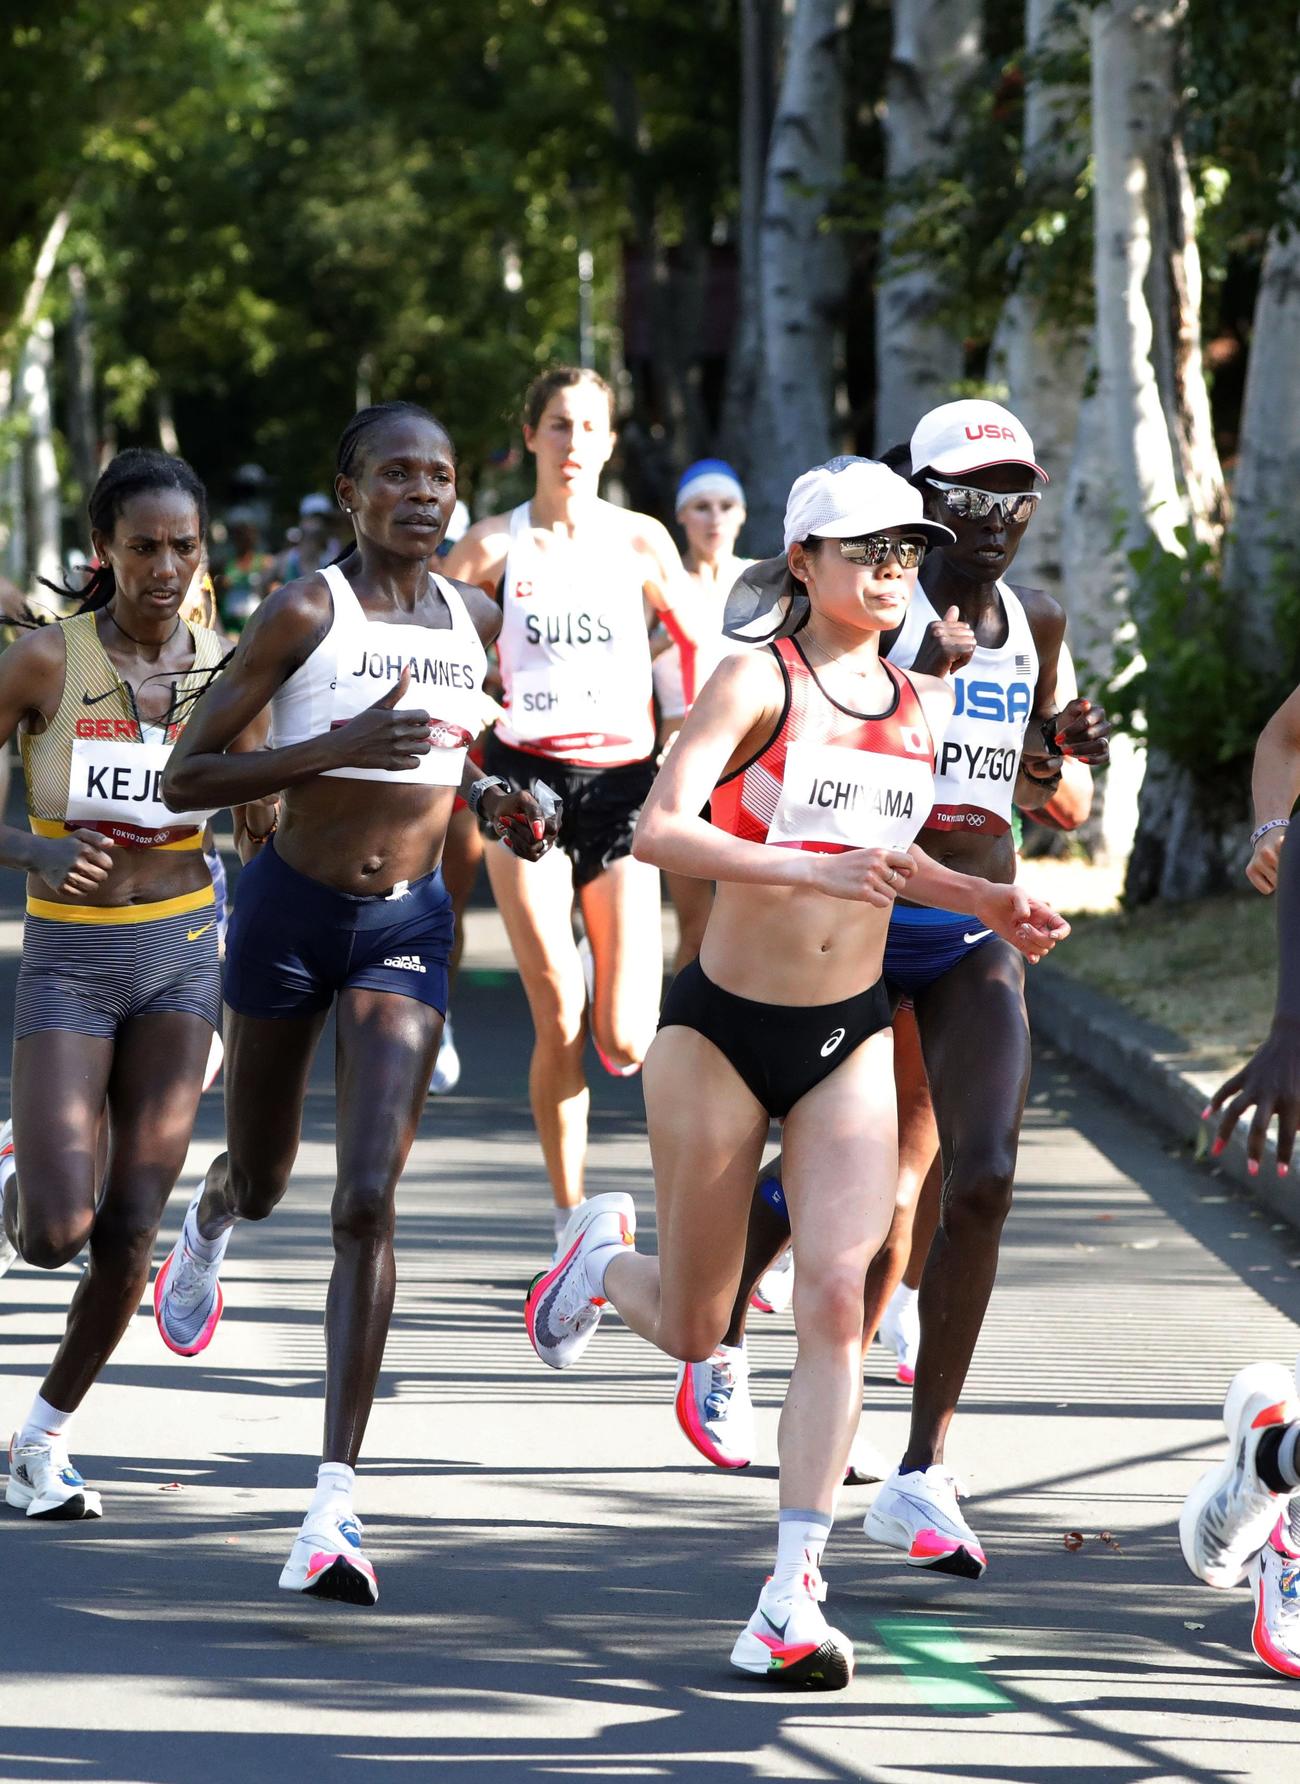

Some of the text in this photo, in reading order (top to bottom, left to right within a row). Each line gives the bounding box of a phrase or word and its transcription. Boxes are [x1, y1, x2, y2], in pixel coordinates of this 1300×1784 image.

[965, 424, 1016, 442] USA
[352, 651, 475, 690] JOHANNES
[808, 778, 913, 819] ICHIAMA
[112, 828, 152, 843] TOKYO 2020
[383, 958, 426, 973] adidas
